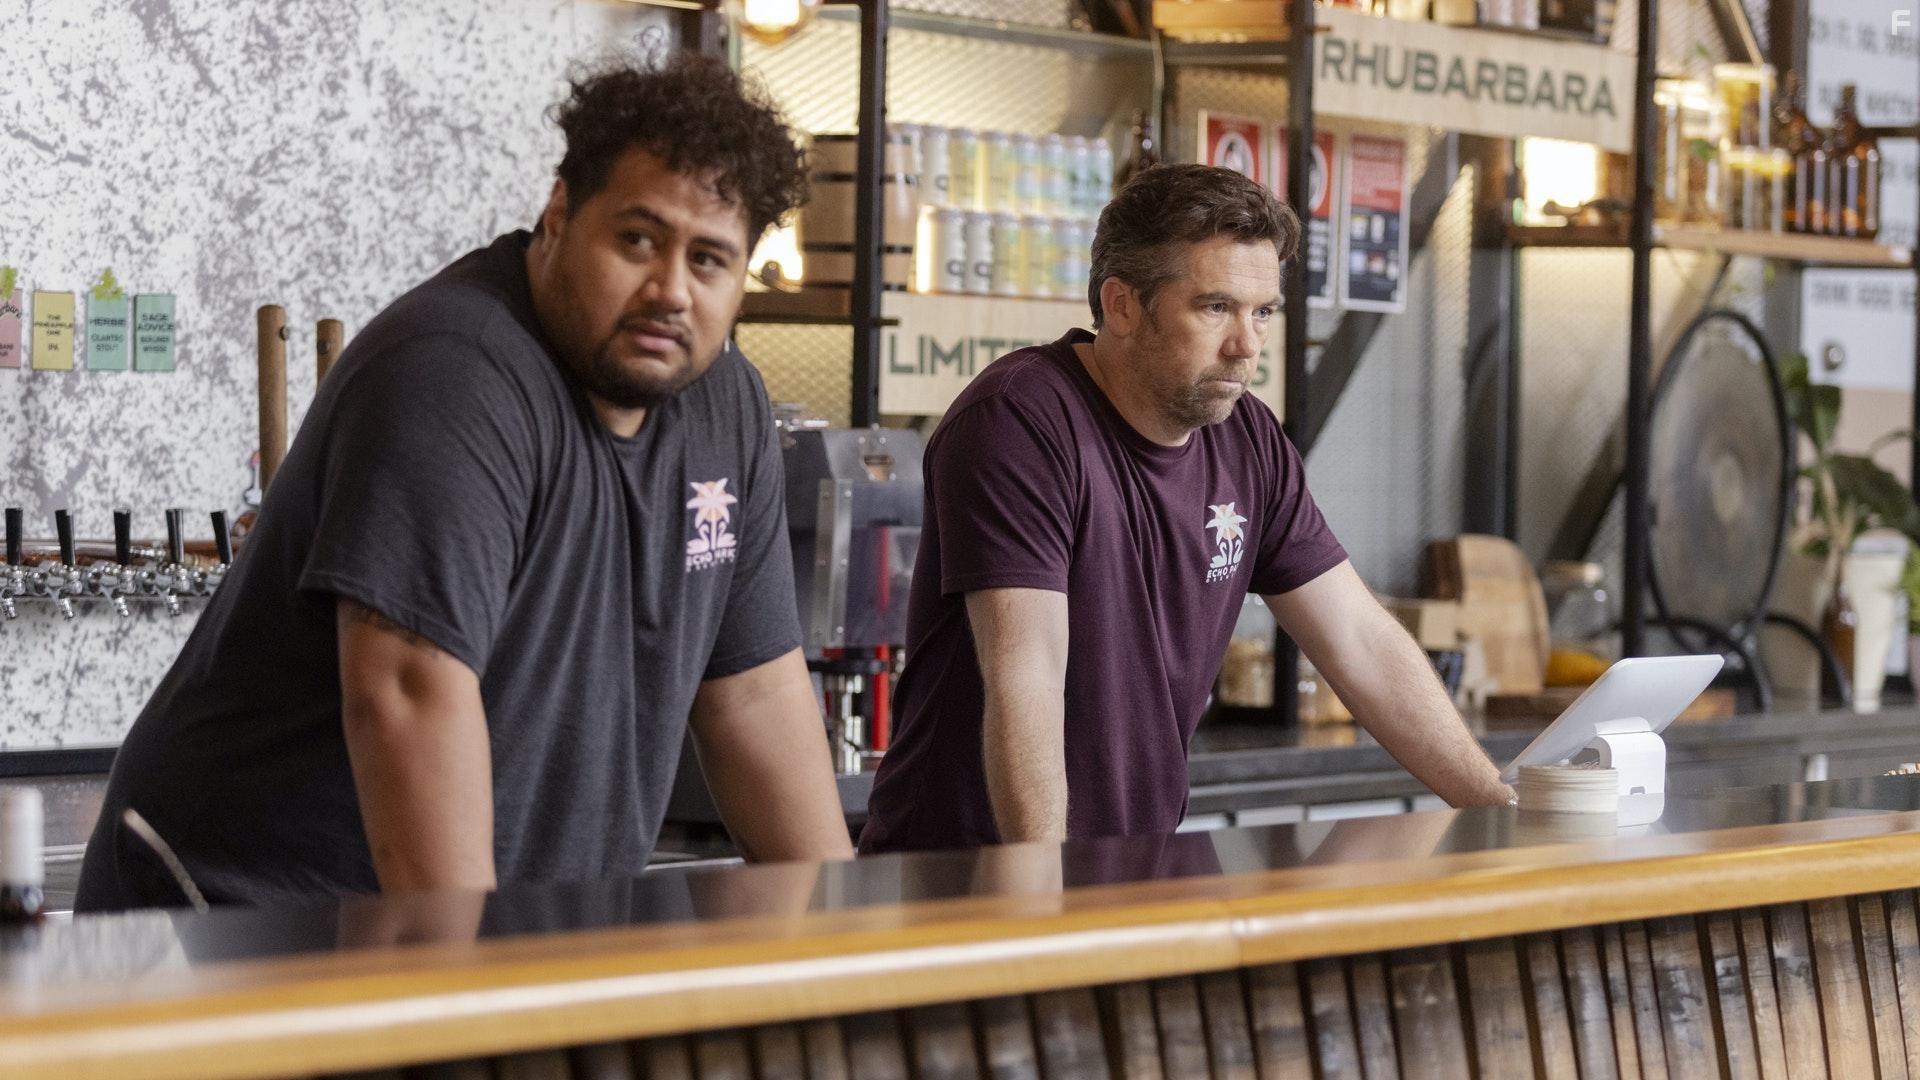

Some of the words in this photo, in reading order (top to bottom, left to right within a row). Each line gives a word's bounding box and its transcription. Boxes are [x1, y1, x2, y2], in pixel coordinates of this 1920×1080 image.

[1320, 37, 1617, 118] RHUBARBARA
[137, 322, 174, 331] ADVICE
[1207, 566, 1228, 578] ECHO
